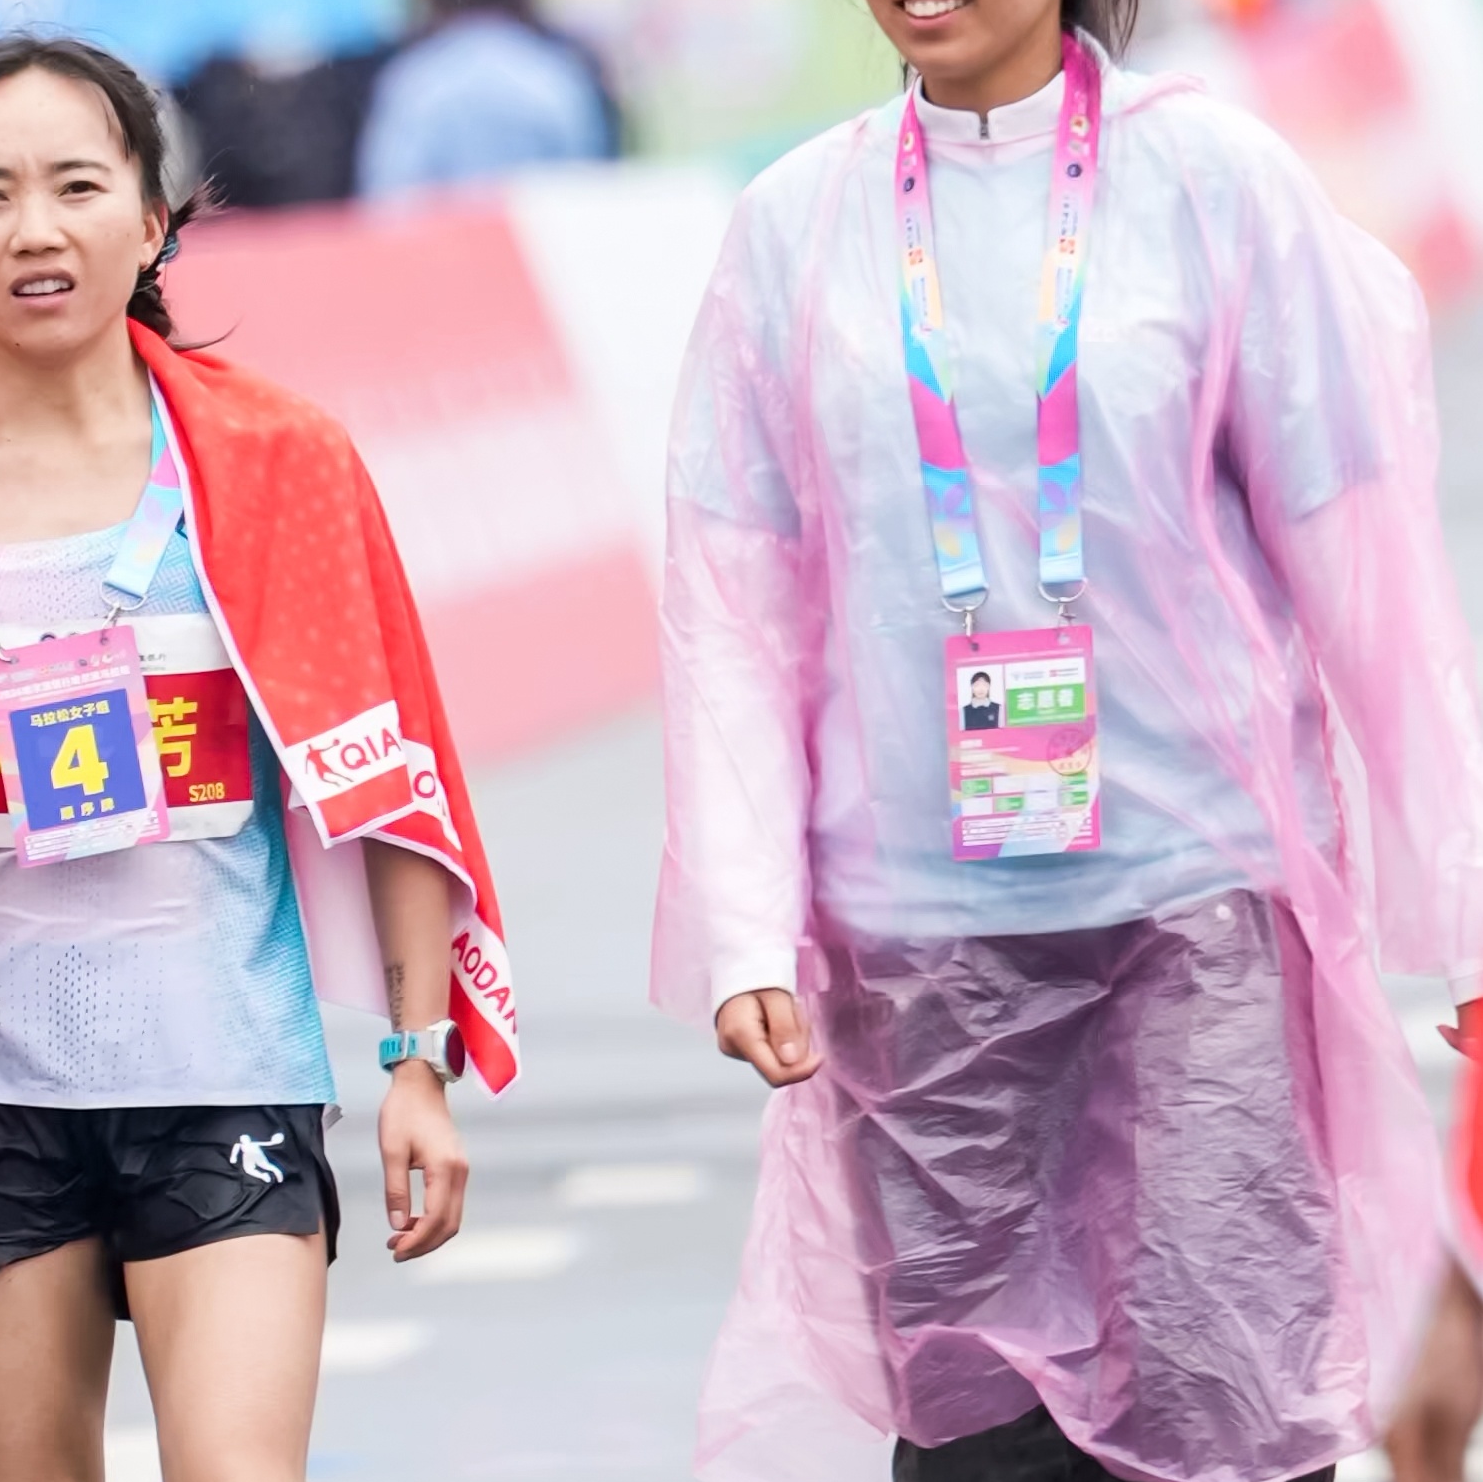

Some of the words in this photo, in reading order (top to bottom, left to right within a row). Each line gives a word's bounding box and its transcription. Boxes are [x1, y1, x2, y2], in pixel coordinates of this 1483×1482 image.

[30, 700, 111, 728] 马拉松女子组
[50, 723, 110, 797] 4
[189, 782, 226, 803] S208
